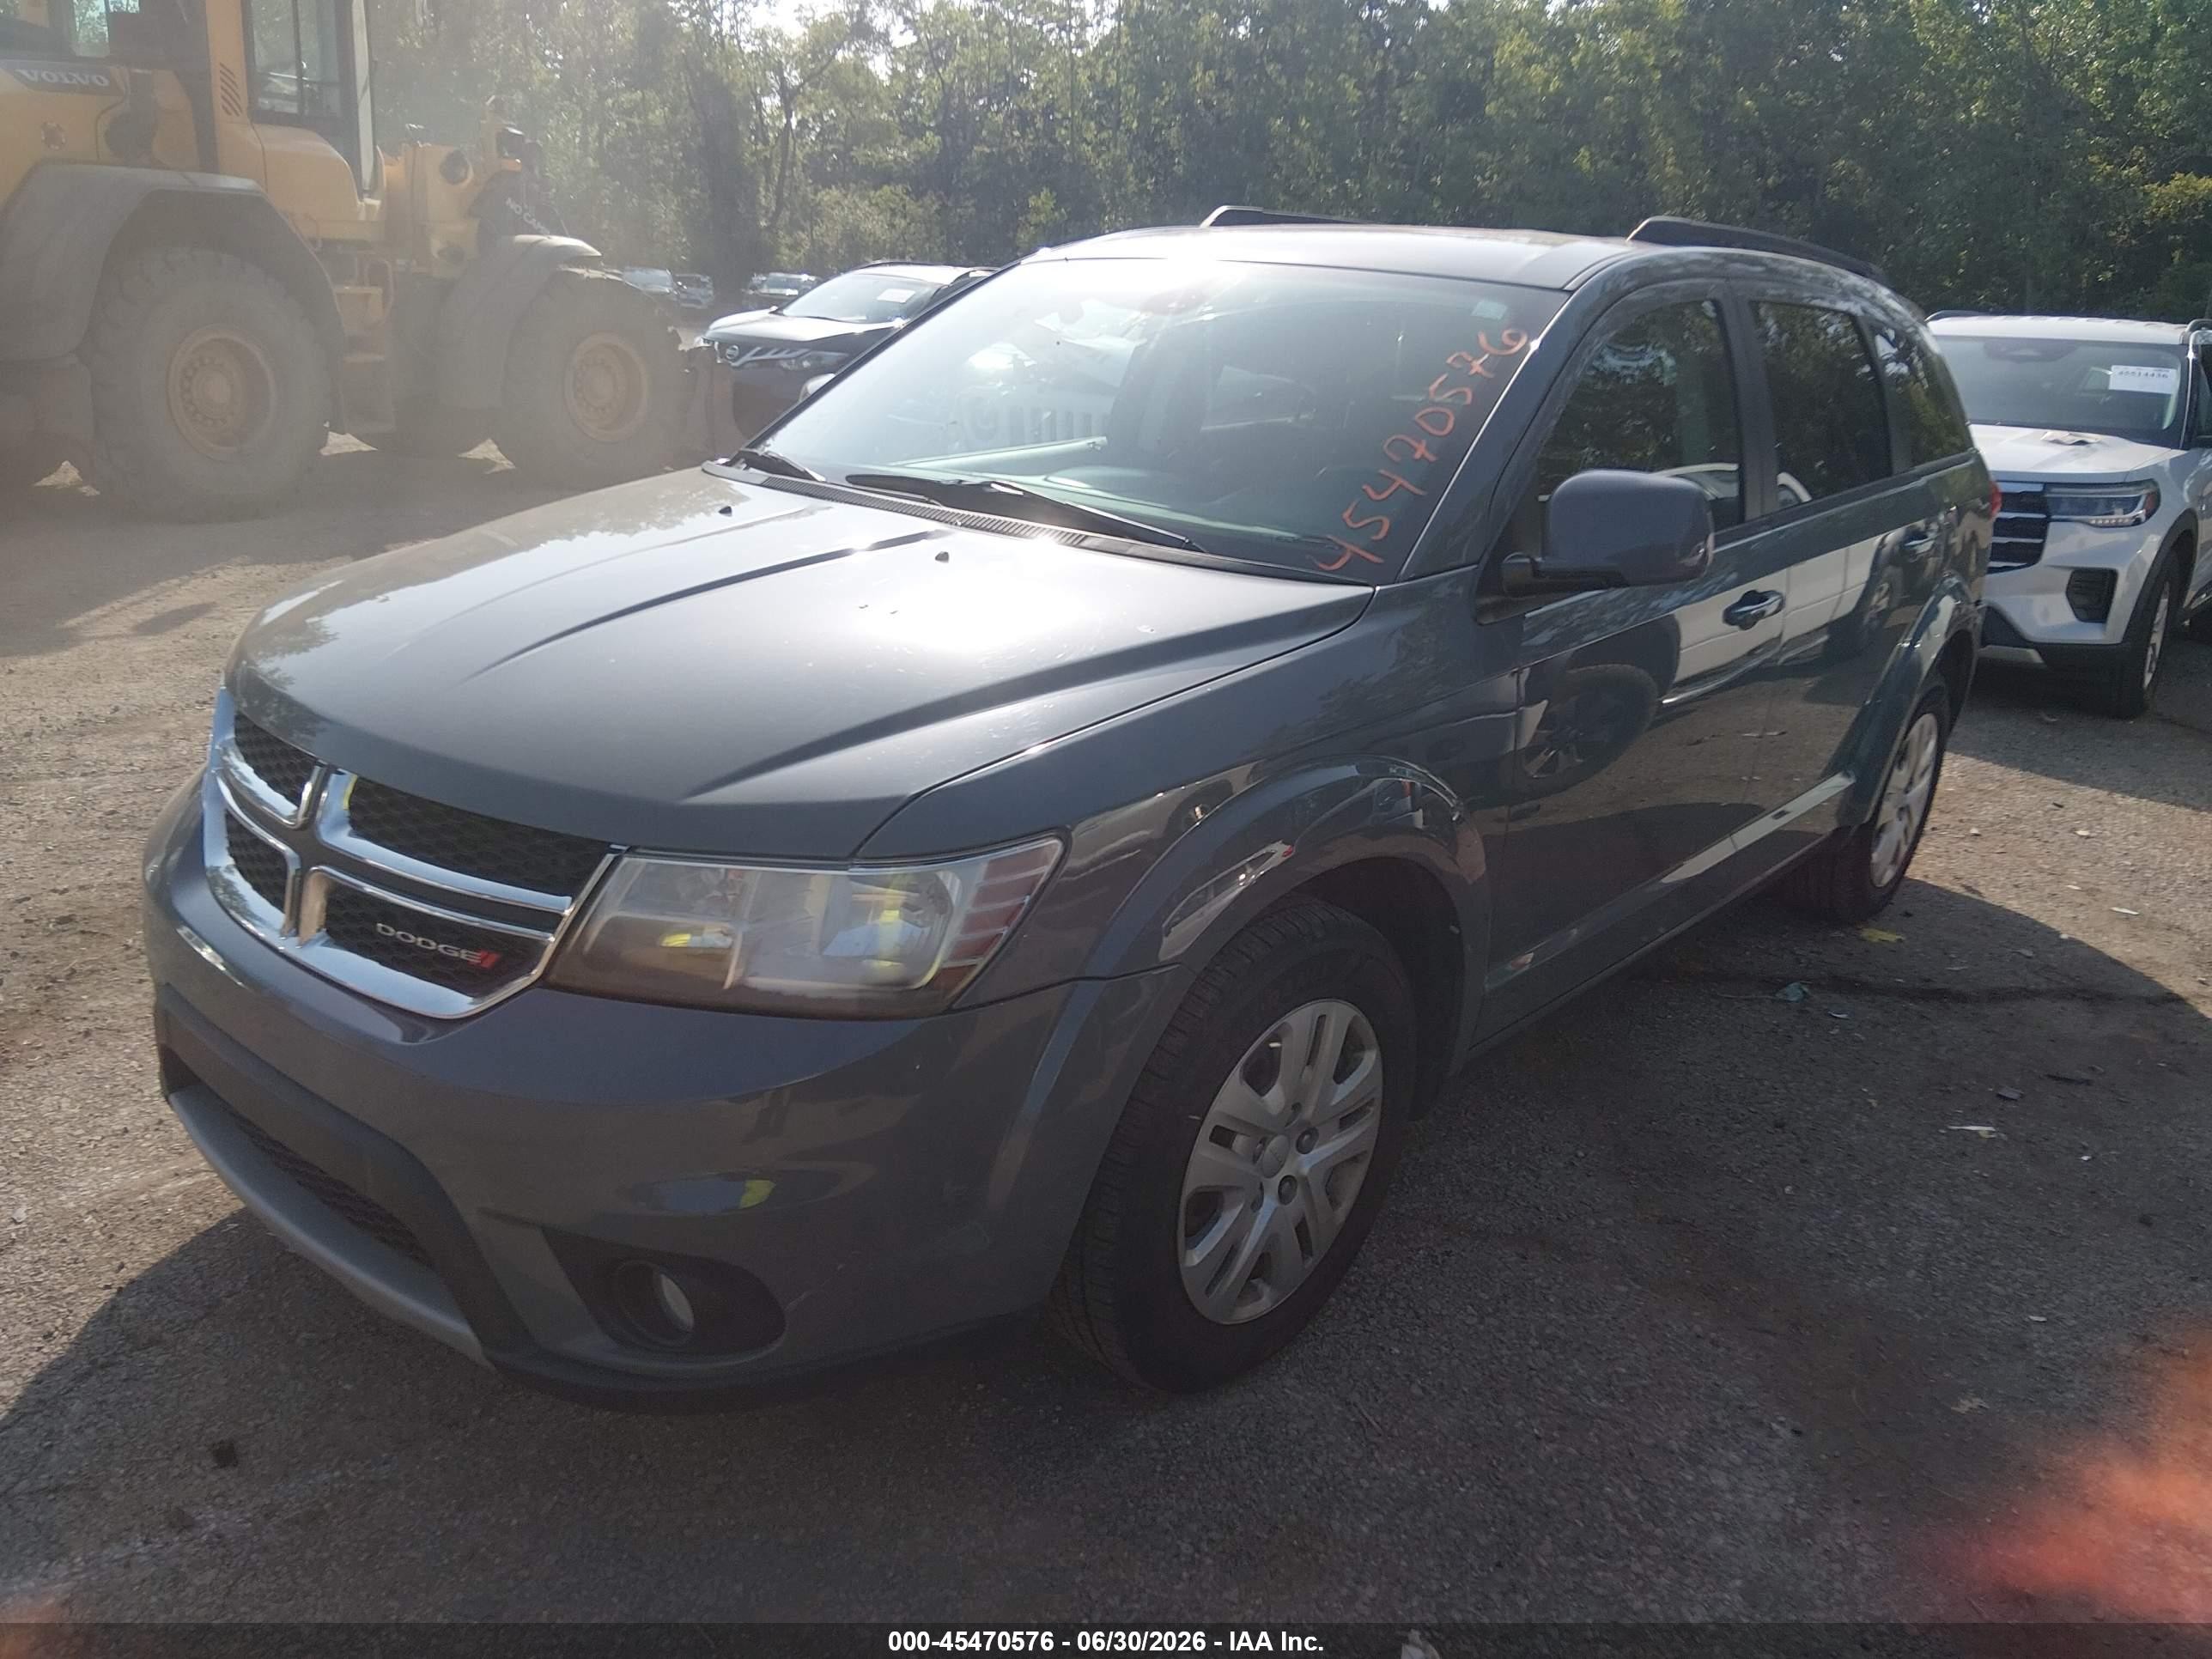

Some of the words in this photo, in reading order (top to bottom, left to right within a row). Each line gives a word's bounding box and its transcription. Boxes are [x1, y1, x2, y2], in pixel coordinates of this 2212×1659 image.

[15, 68, 110, 87] VOLVO
[1306, 328, 1528, 570] 45470576
[376, 922, 483, 964] DODGE
